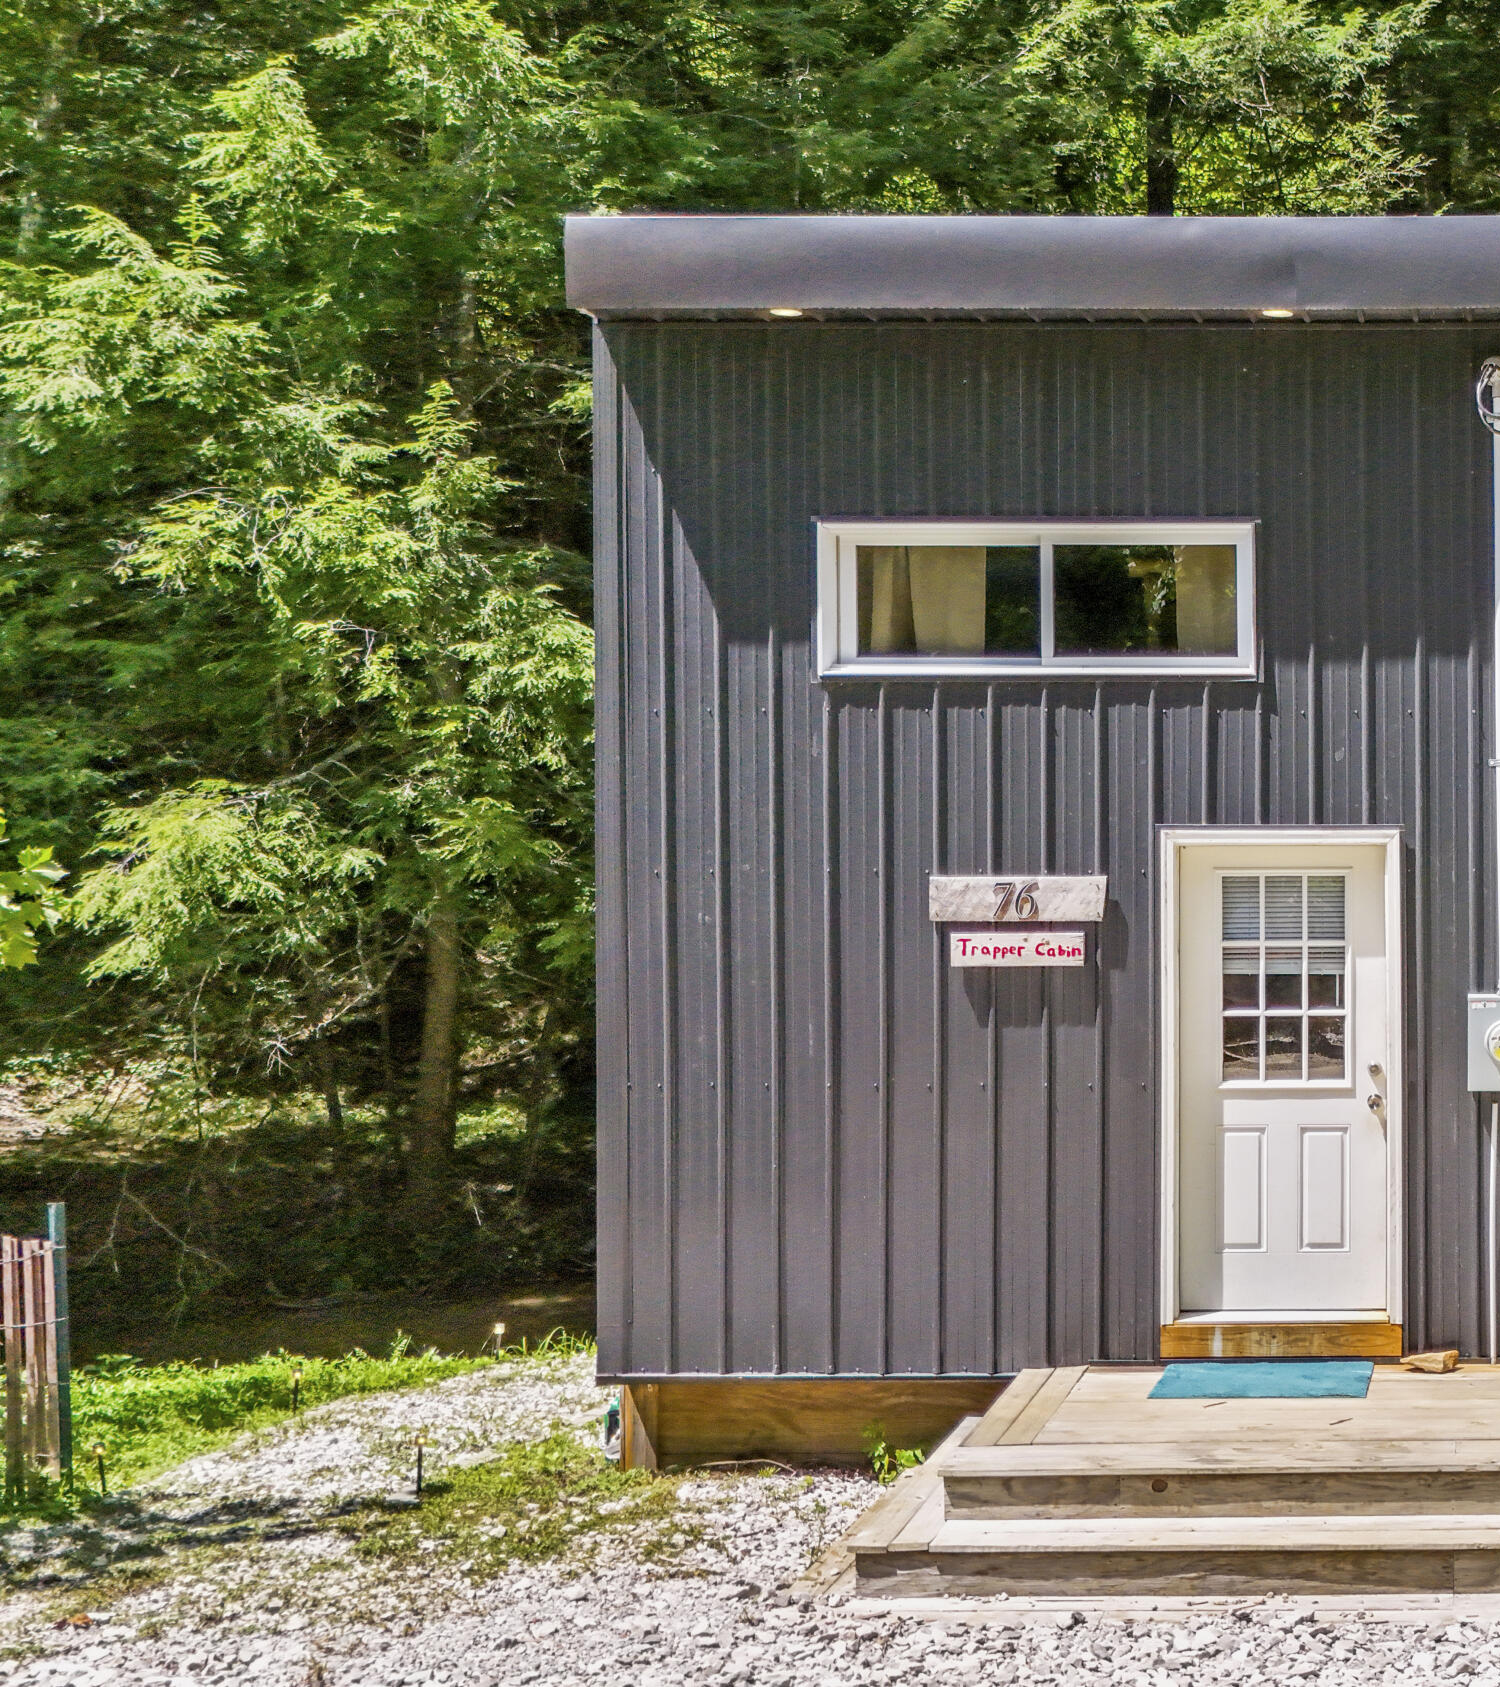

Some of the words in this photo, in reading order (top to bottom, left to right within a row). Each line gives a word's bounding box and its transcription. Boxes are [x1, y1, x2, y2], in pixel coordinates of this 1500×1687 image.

[993, 882, 1038, 919] 76
[957, 938, 1025, 959] Trapper
[1035, 943, 1082, 957] Cabin
